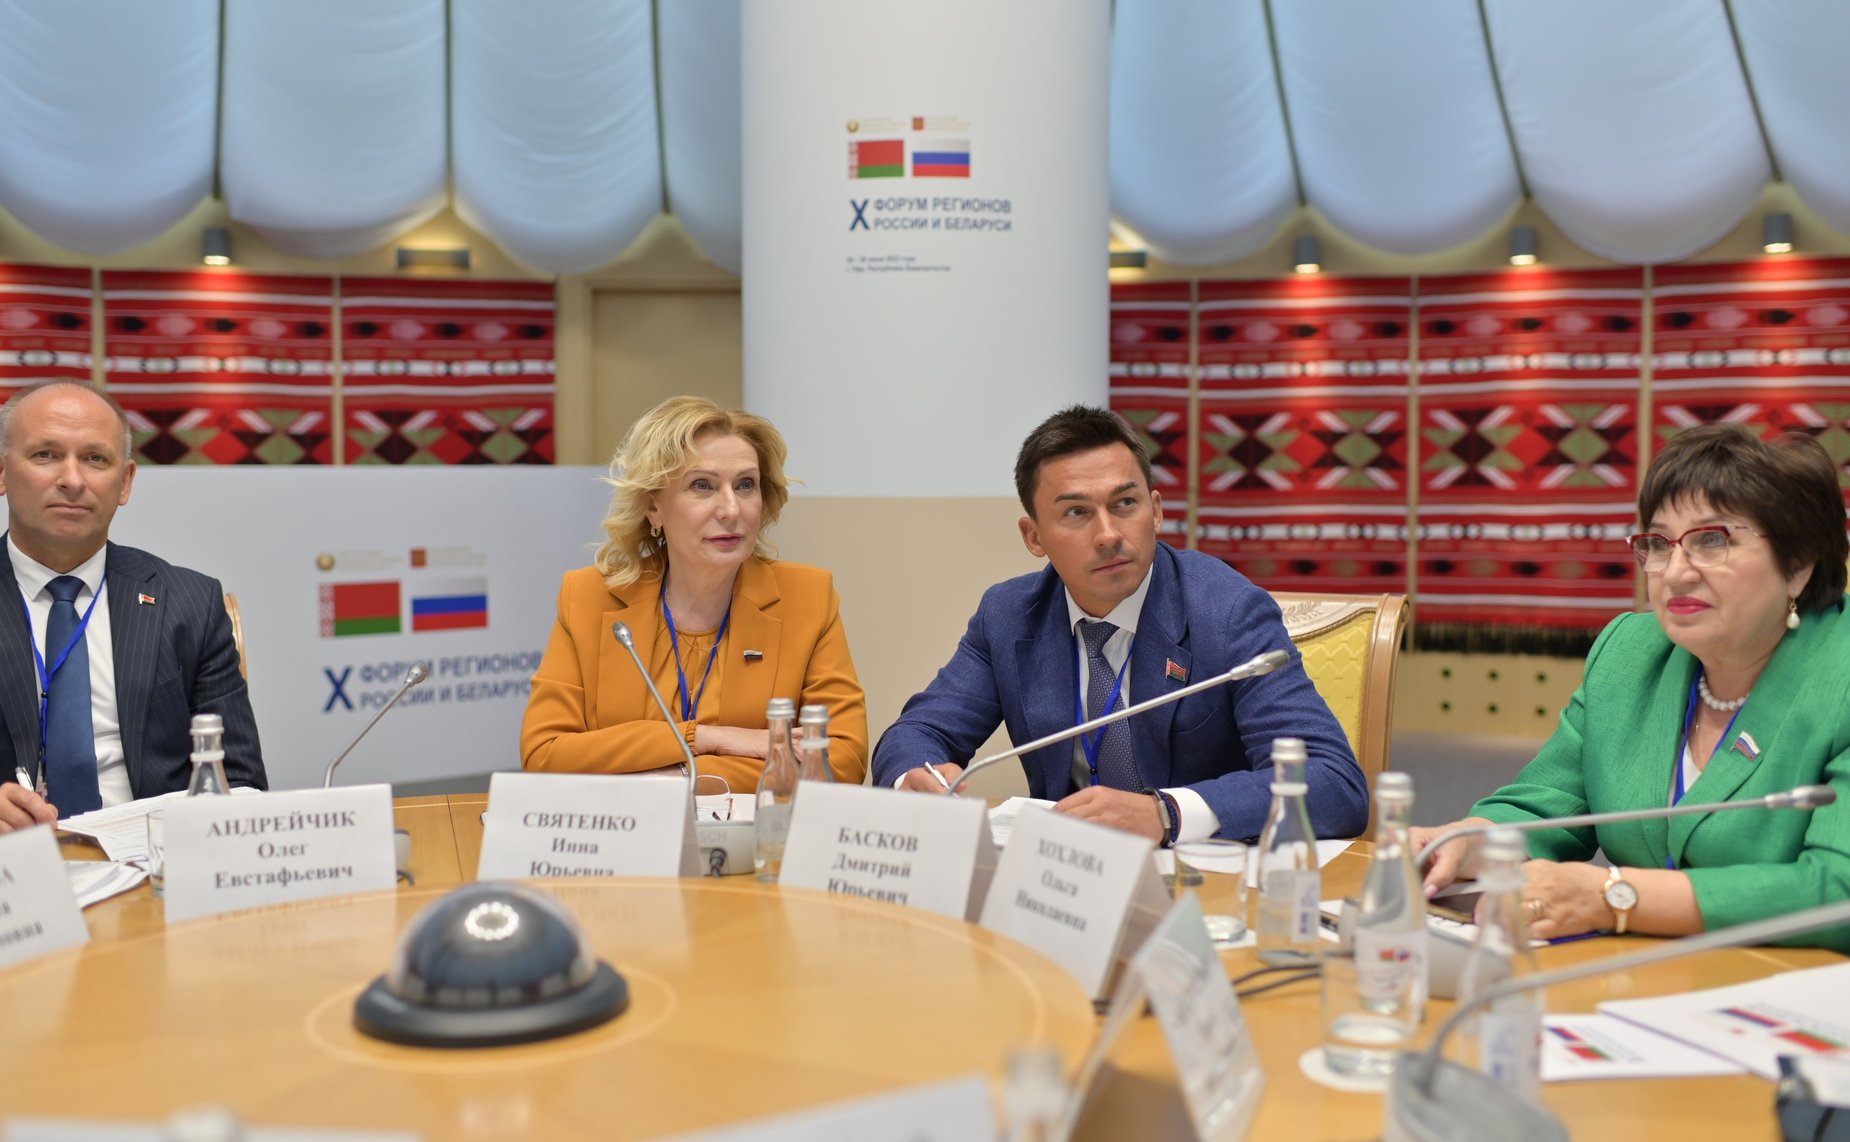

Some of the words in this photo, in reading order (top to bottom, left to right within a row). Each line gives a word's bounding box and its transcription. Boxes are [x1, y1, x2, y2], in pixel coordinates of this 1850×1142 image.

[874, 198, 928, 212] ФОРУМ
[932, 198, 1012, 214] РЕГИОНОВ
[874, 217, 929, 230] РОССИИ
[932, 218, 941, 230] И
[945, 217, 1013, 232] БЕЛАРУСИ
[457, 679, 531, 702] БЕЛАРУС
[206, 810, 356, 838] АНДРЕЙЧИК
[523, 811, 637, 832] СВЯТЕНКО
[257, 842, 310, 859] Олег
[551, 837, 599, 854] Инна
[838, 827, 919, 853] БАСКОВ
[832, 853, 912, 878] Дмитрий
[214, 864, 353, 890] Евстафьевич
